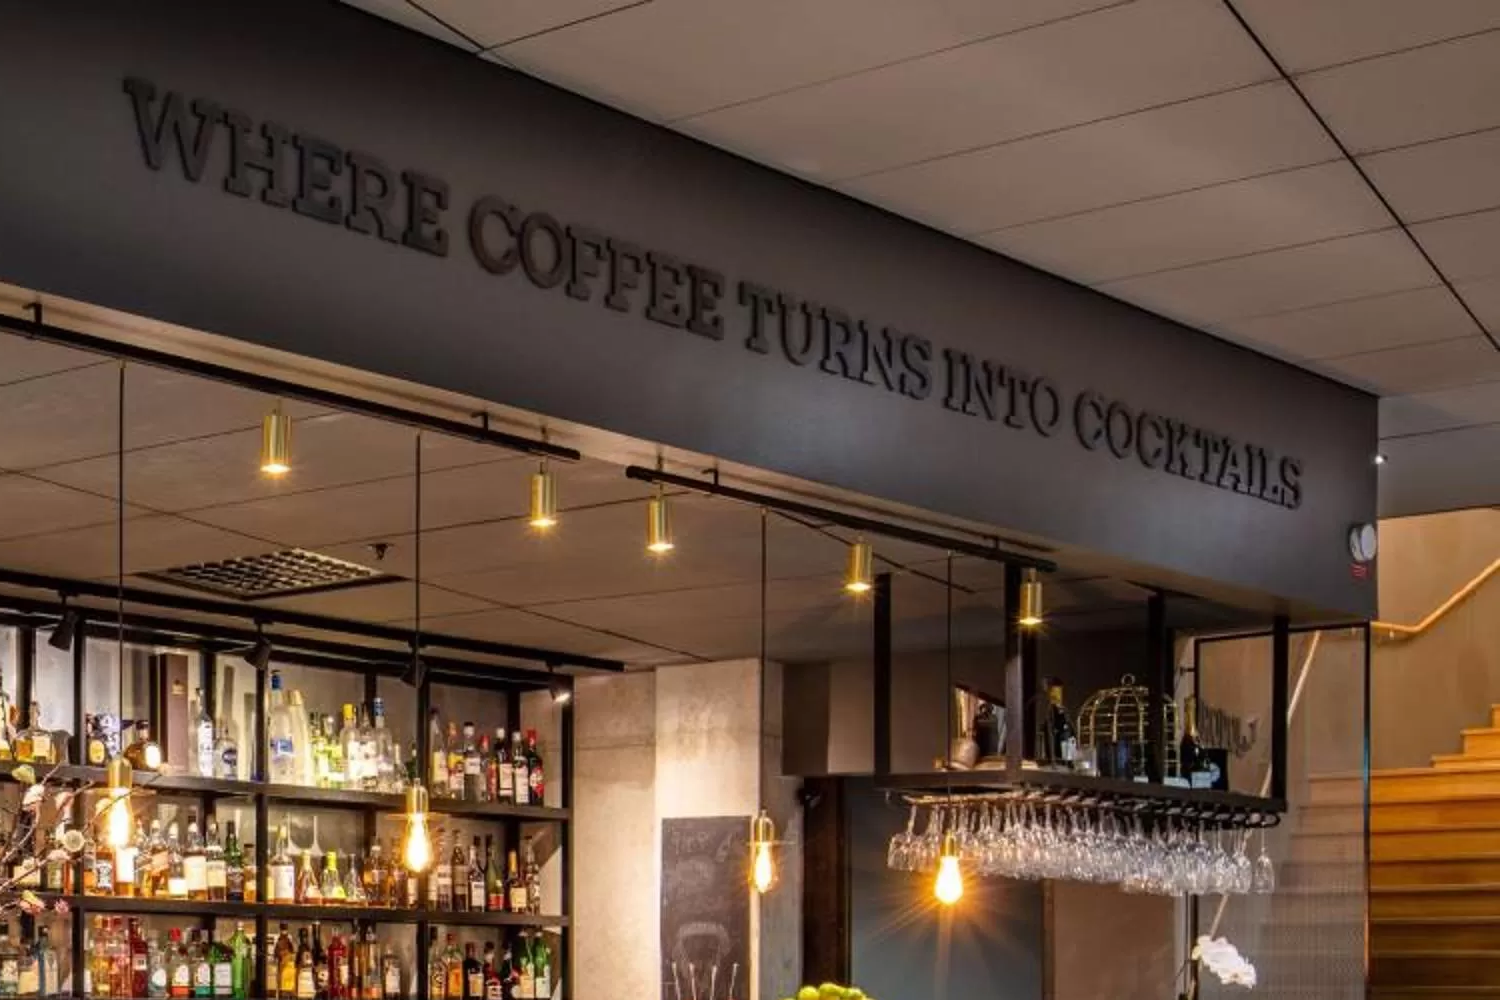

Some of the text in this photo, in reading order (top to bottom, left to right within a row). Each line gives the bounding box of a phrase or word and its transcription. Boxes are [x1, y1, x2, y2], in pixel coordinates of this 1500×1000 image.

[122, 76, 1302, 511] WHERE COFFEE TURNS INTO COCKTAILS
